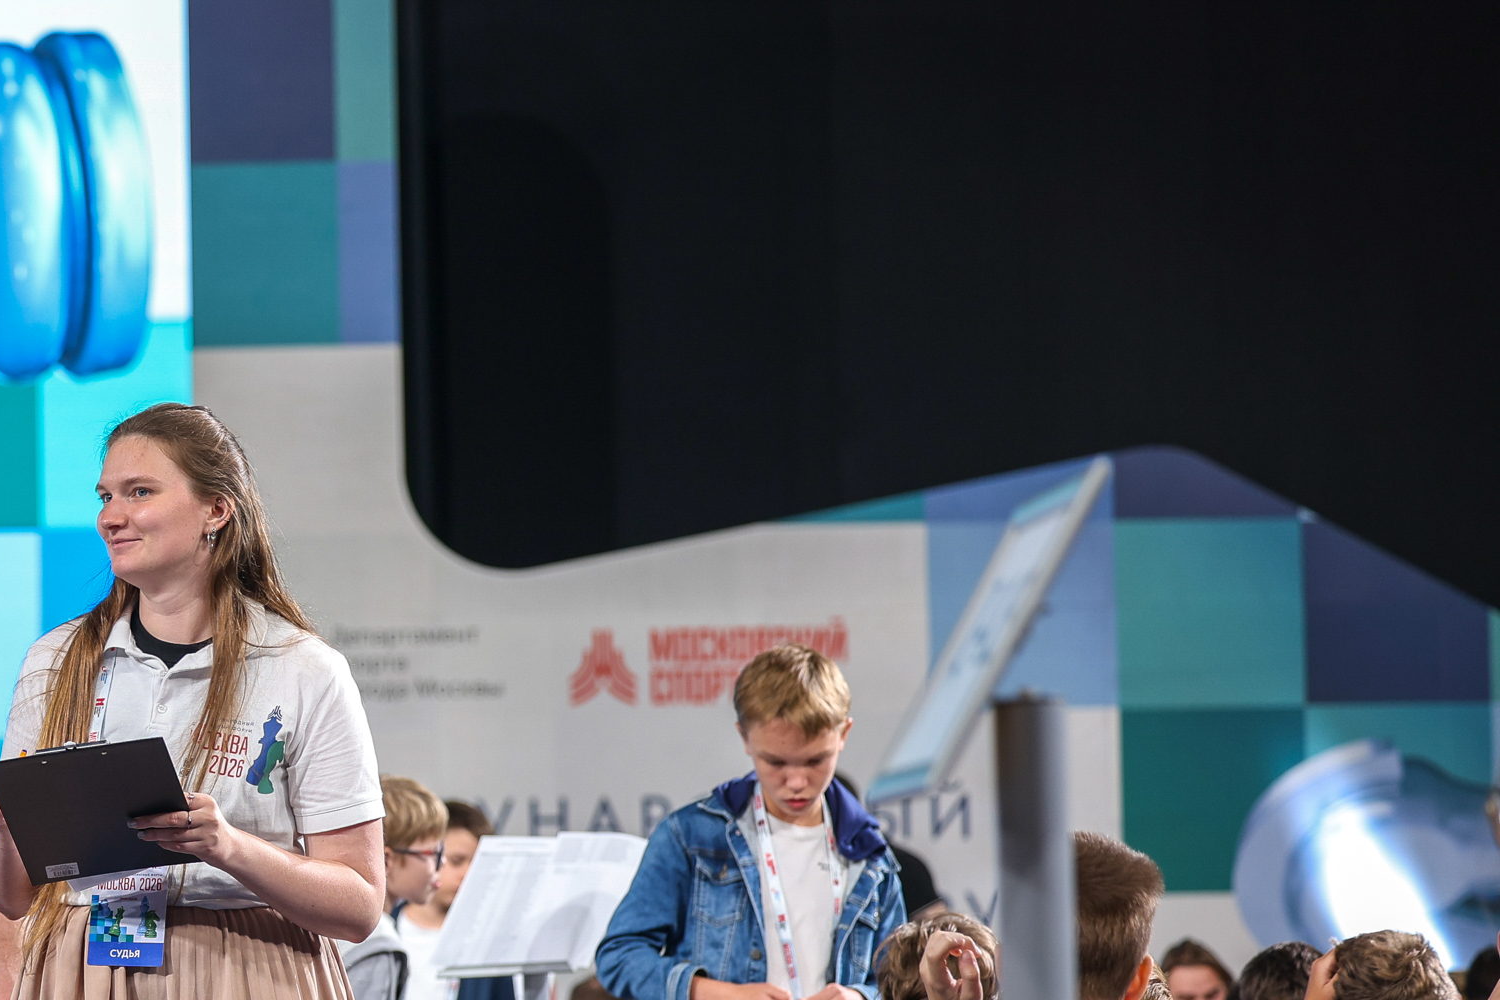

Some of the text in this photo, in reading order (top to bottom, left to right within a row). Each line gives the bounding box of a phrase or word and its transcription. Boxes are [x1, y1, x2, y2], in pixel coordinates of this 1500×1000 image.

[208, 754, 245, 778] 2026
[139, 877, 162, 891] 2026
[109, 948, 140, 960] СУДЬЯ
